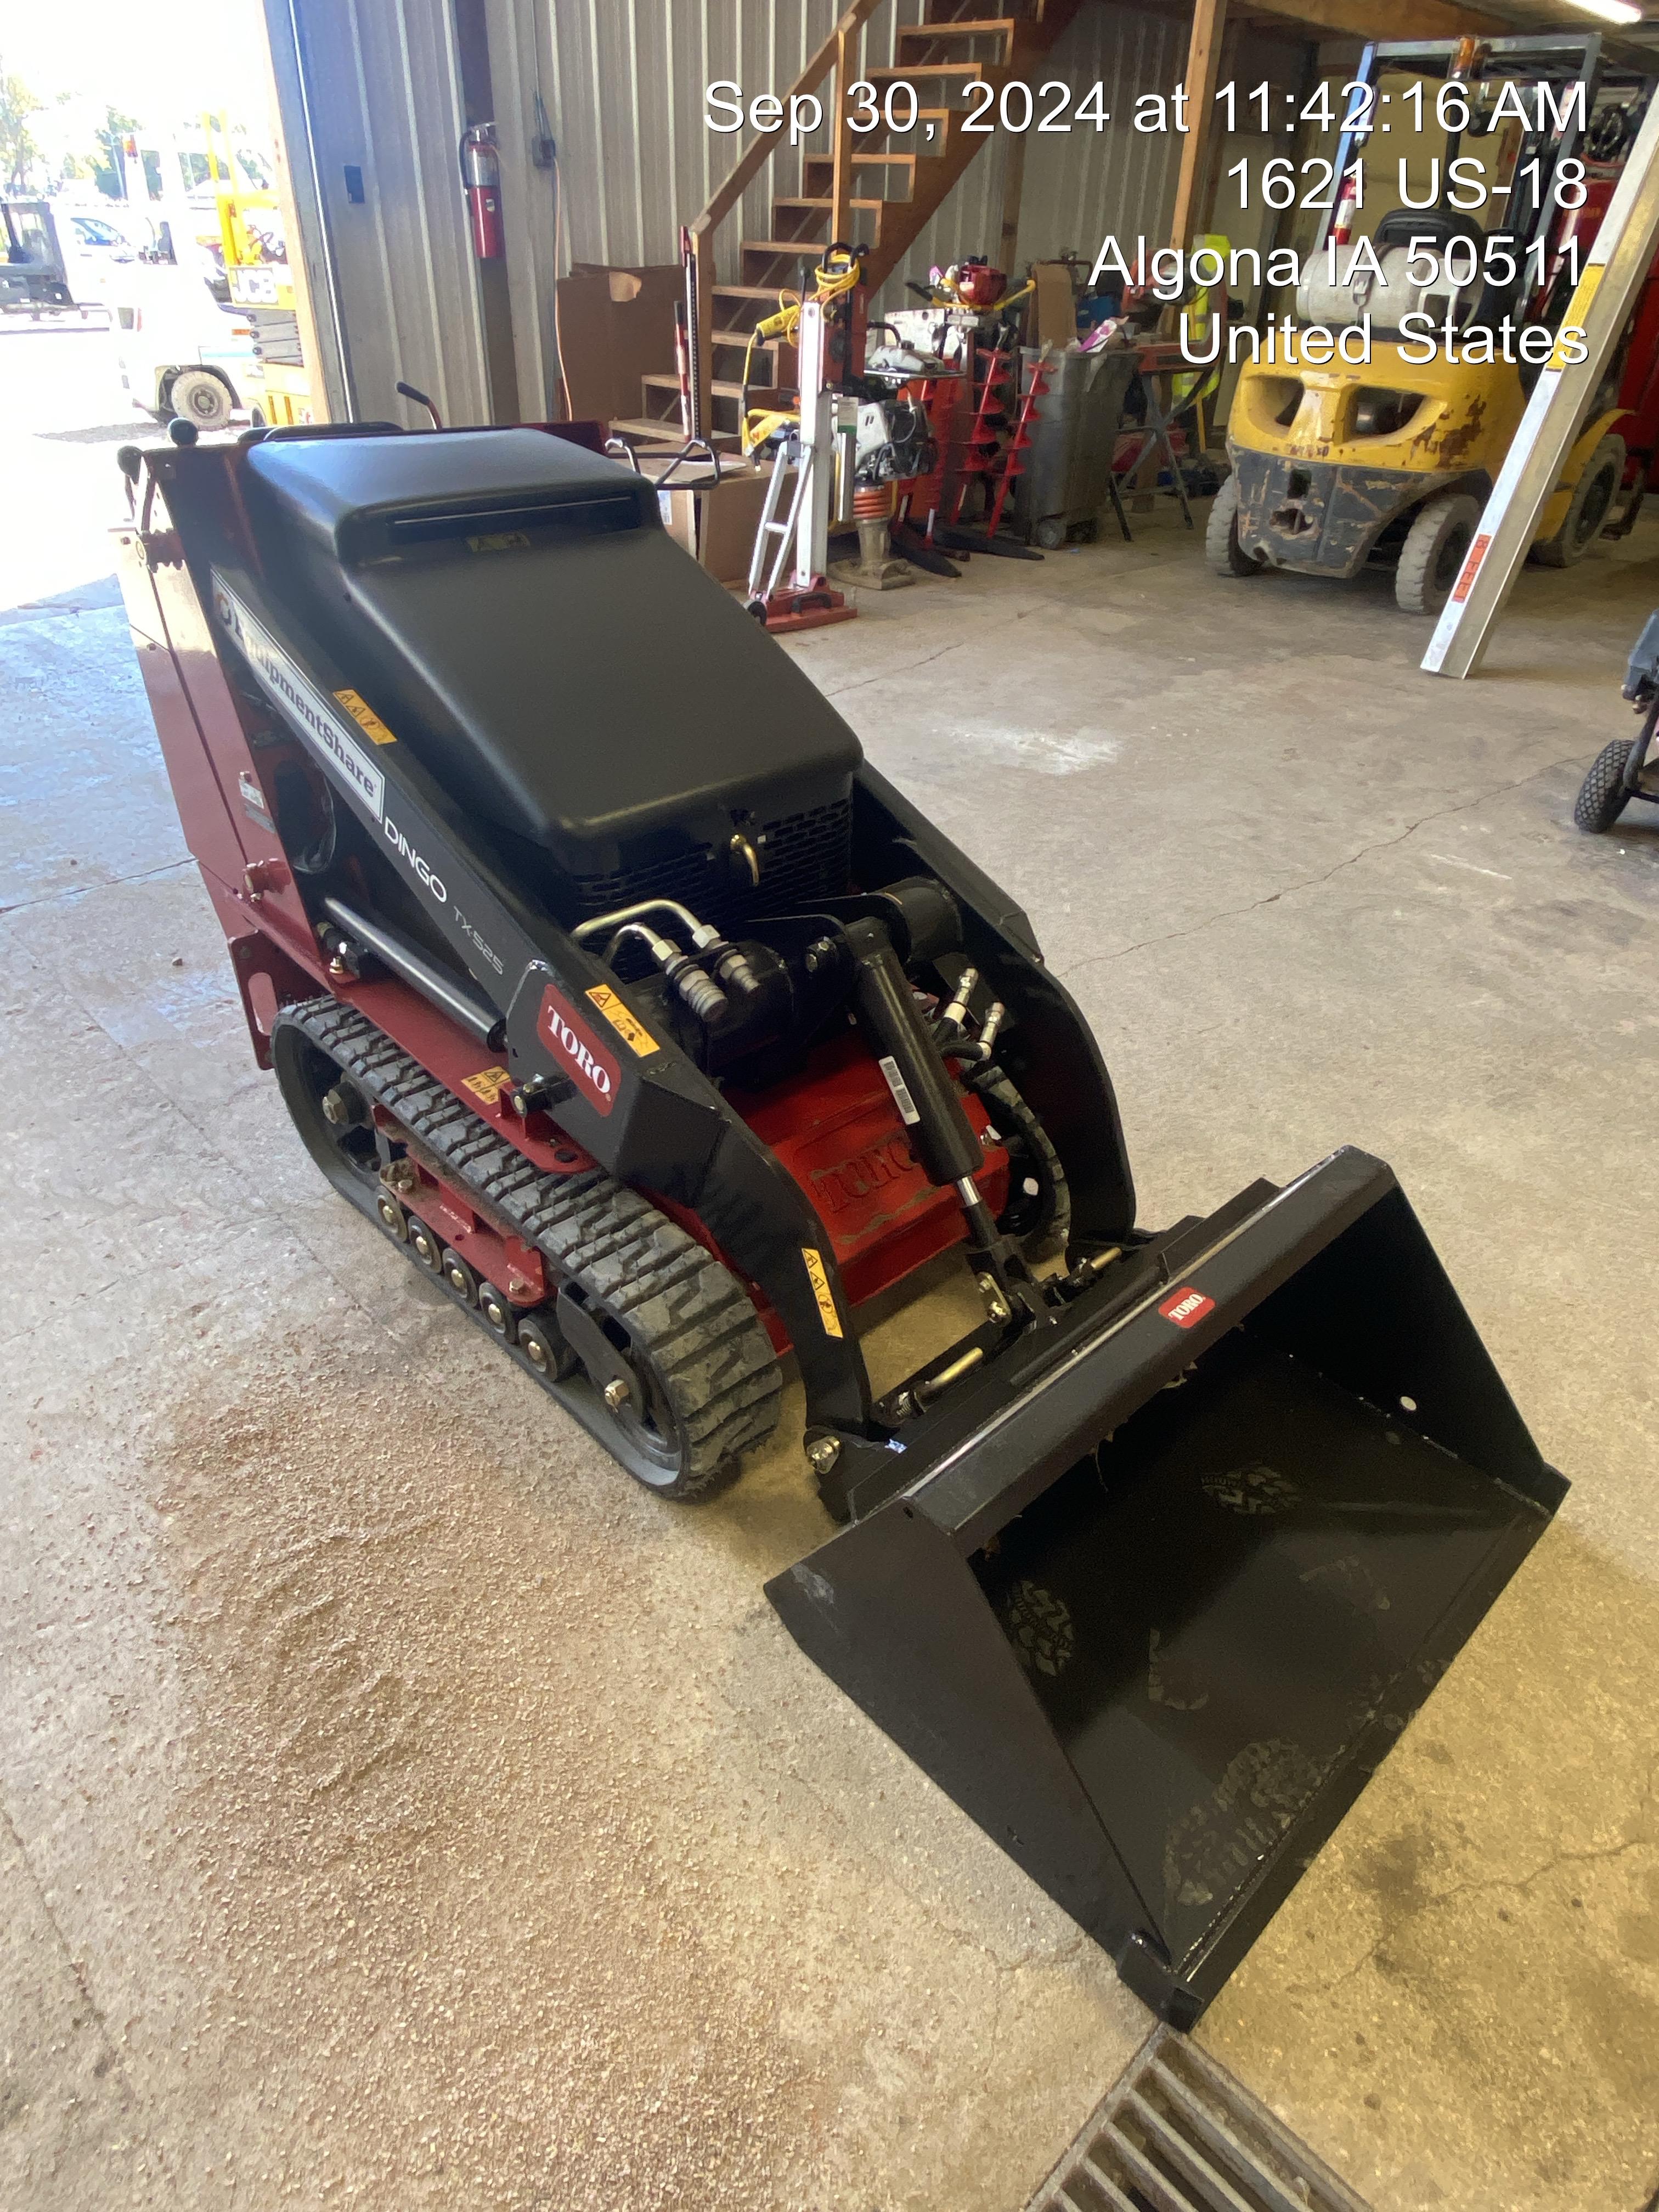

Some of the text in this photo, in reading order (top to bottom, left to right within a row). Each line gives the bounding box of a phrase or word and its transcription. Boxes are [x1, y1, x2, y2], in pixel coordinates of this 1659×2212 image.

[233, 268, 278, 304] JCB
[384, 816, 447, 903] DINGO
[548, 1005, 611, 1093] TORO
[1167, 1294, 1204, 1321] TORO
